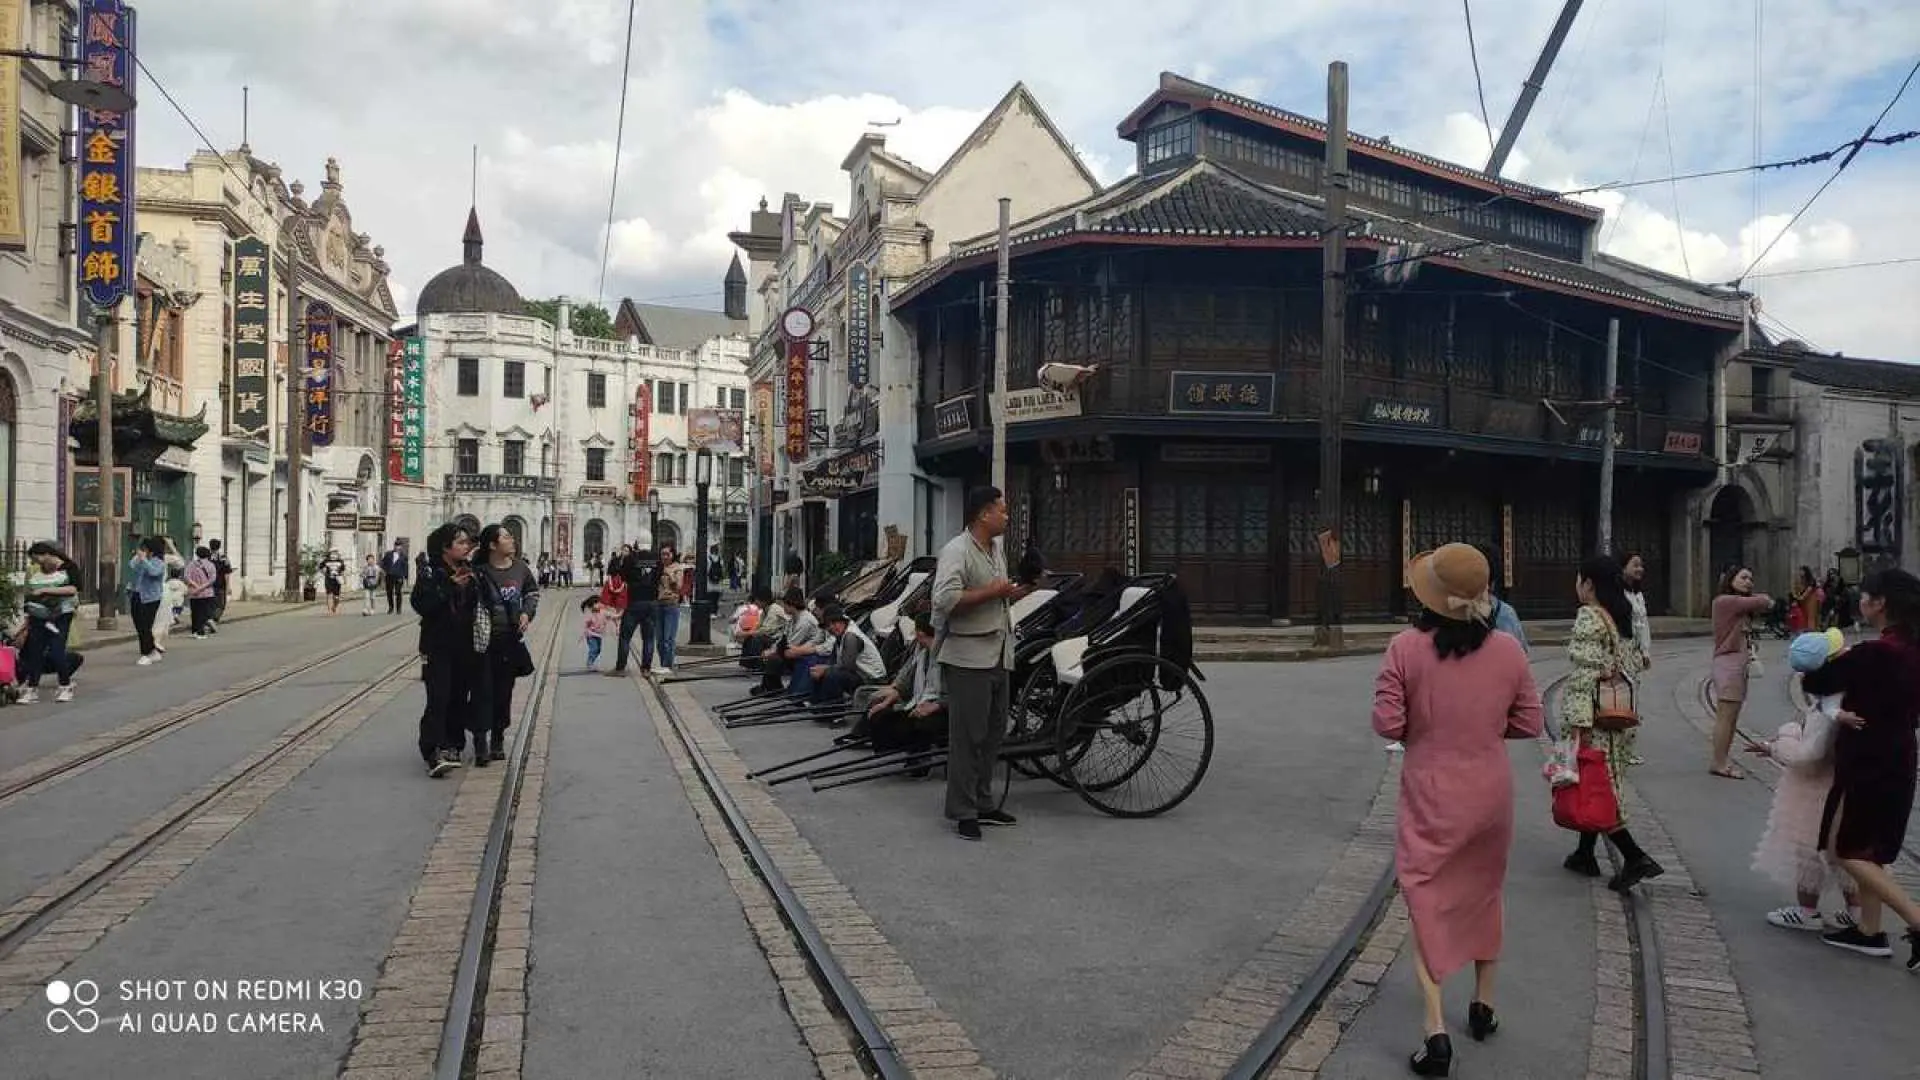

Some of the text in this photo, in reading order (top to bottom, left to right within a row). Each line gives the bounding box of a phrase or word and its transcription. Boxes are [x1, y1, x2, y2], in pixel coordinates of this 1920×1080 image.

[237, 256, 265, 413] 萬生堂國貨
